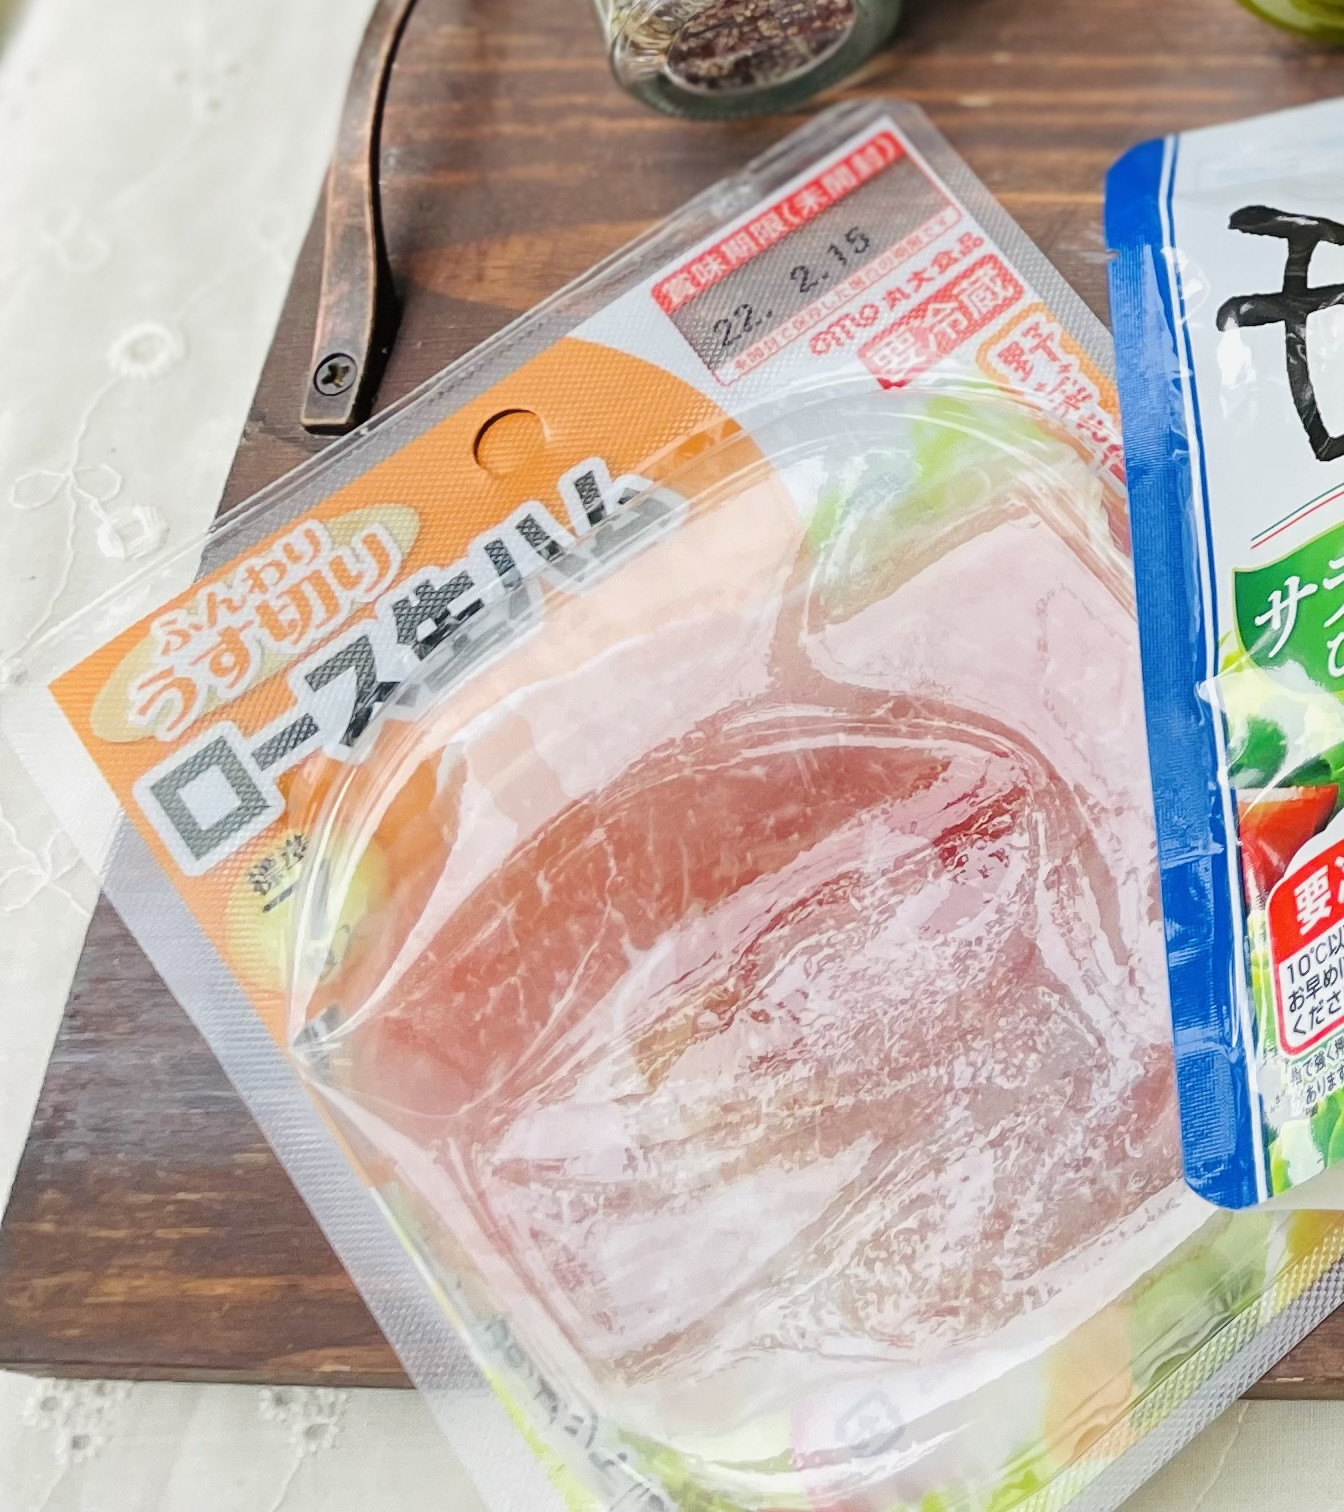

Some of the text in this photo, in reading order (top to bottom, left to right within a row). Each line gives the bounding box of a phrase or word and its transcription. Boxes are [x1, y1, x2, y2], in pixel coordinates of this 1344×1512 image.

[869, 265, 1016, 375] 要冷蔵
[881, 230, 986, 312] 丸大食品
[135, 530, 394, 735] うす切り
[155, 524, 321, 657] ふんわり
